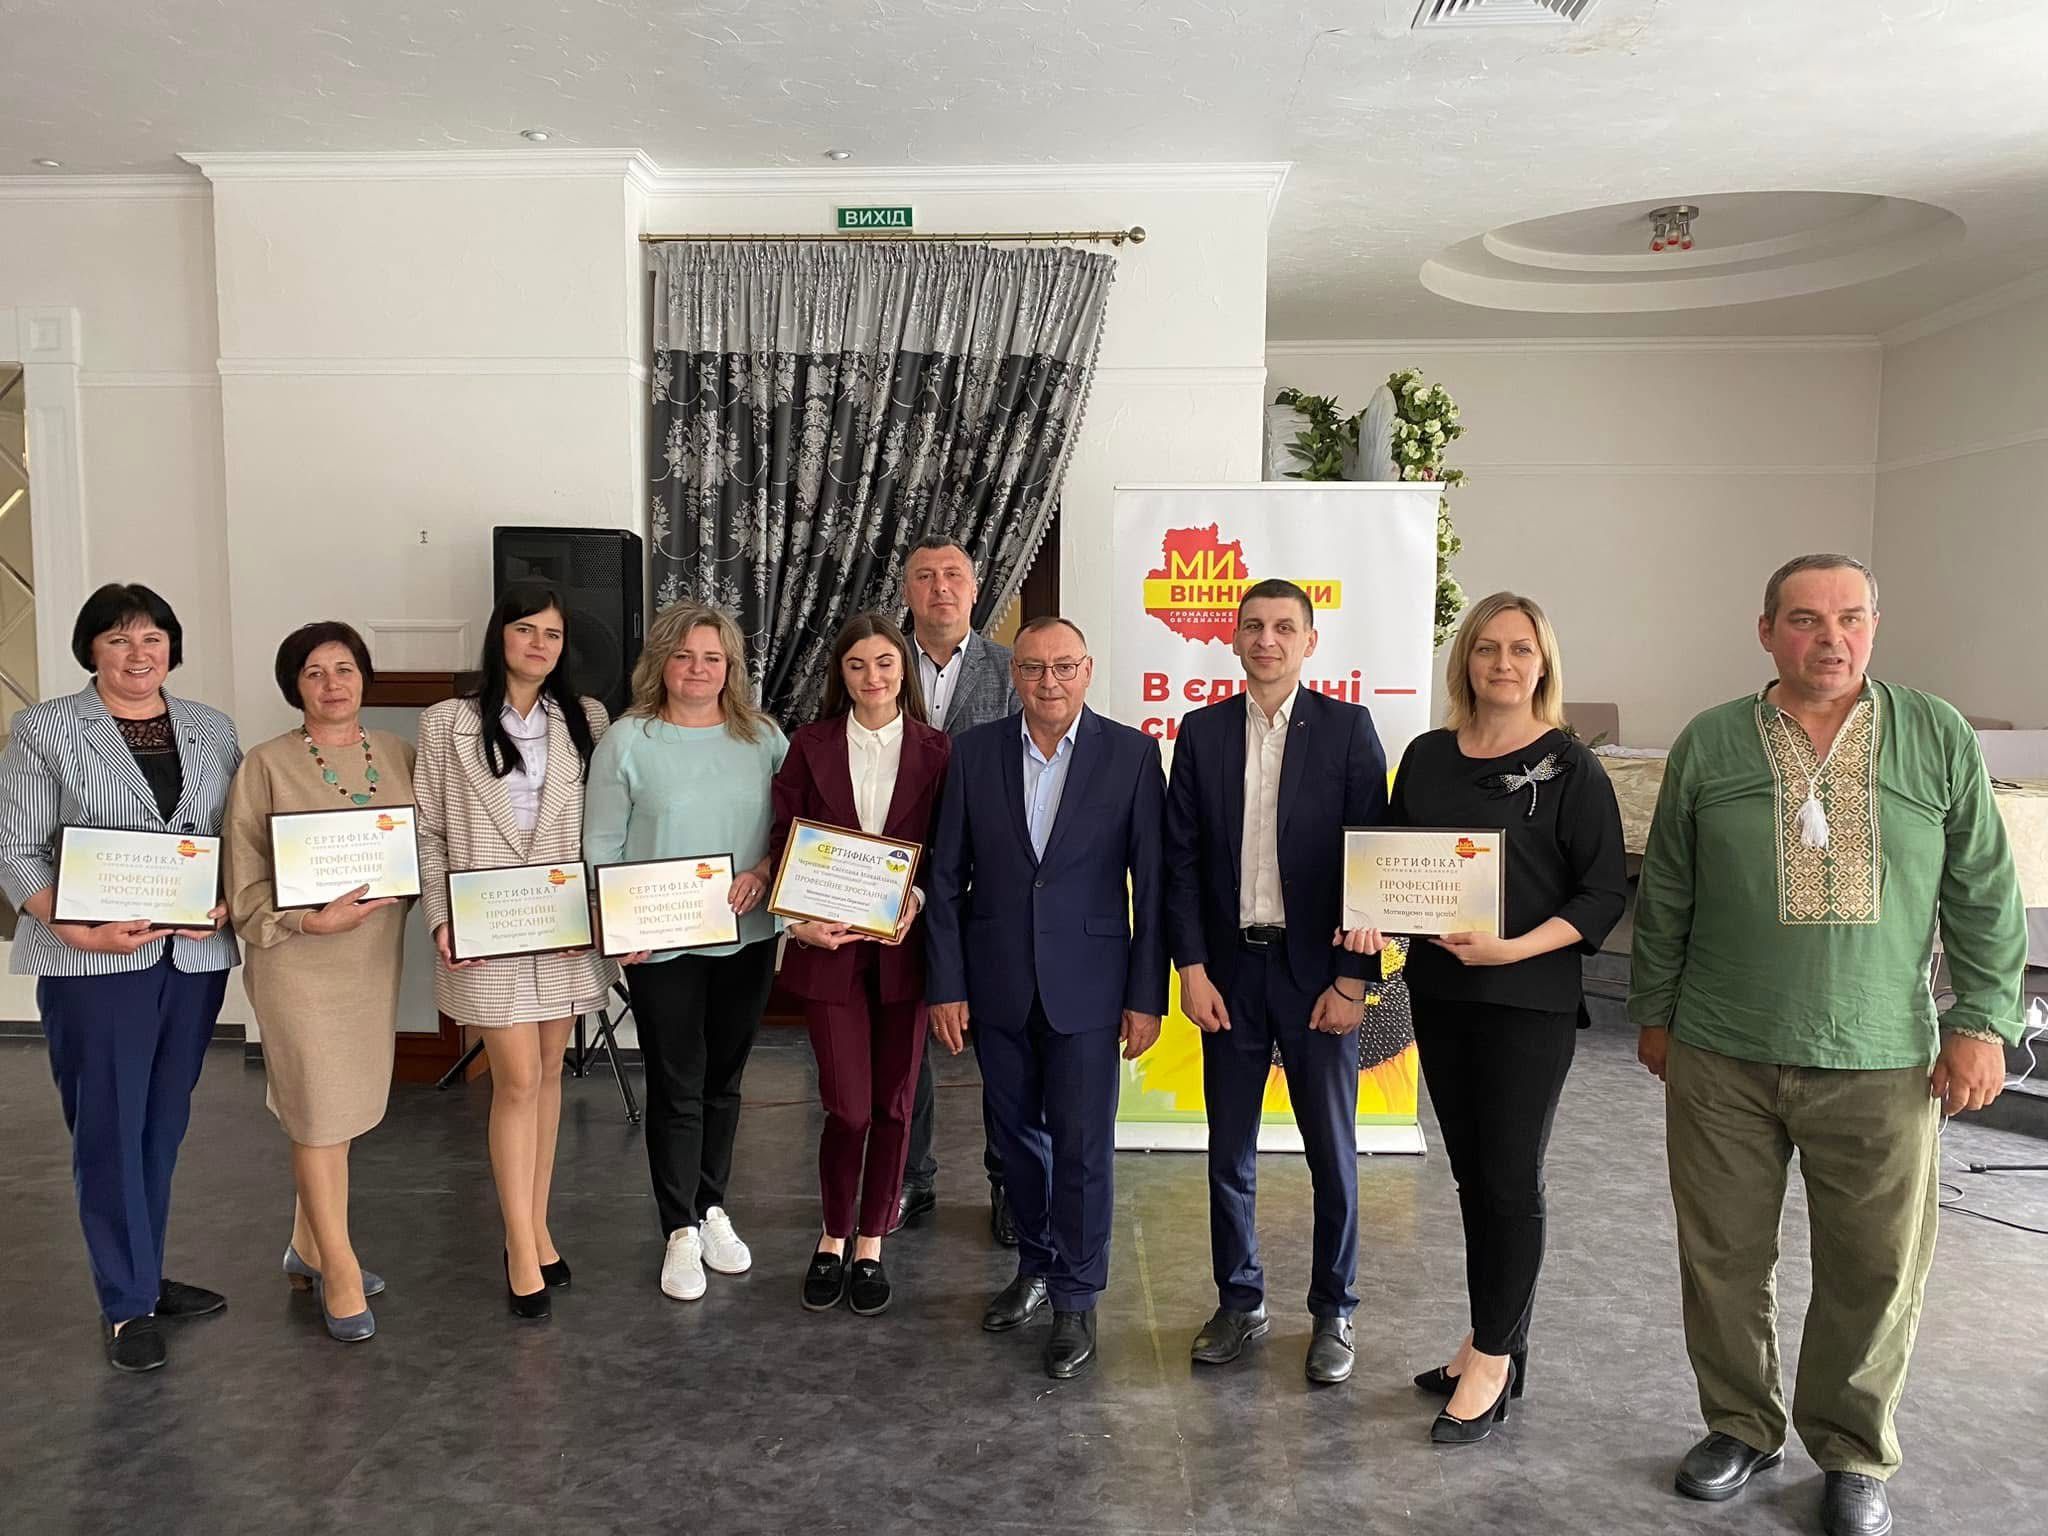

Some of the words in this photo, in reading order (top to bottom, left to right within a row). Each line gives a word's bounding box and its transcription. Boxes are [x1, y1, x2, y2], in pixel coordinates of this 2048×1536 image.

[845, 210, 906, 226] ВИХІД
[1170, 550, 1235, 579] МИ
[1143, 672, 1170, 702] В
[305, 832, 385, 845] СЕРТИФІКАТ
[96, 852, 186, 866] СЕРТИФІКАТ
[817, 843, 883, 865] СЕРТИФІКАТ
[1376, 857, 1466, 868] СЕРТИФІКАТ
[629, 880, 705, 895] СЕРТИФІКАТ
[1379, 879, 1463, 891] ПРОФЕСІЙНЕ
[481, 886, 558, 900] СЕРТИФІКАТ
[1382, 893, 1458, 905] ЗРОСТАННЯ
